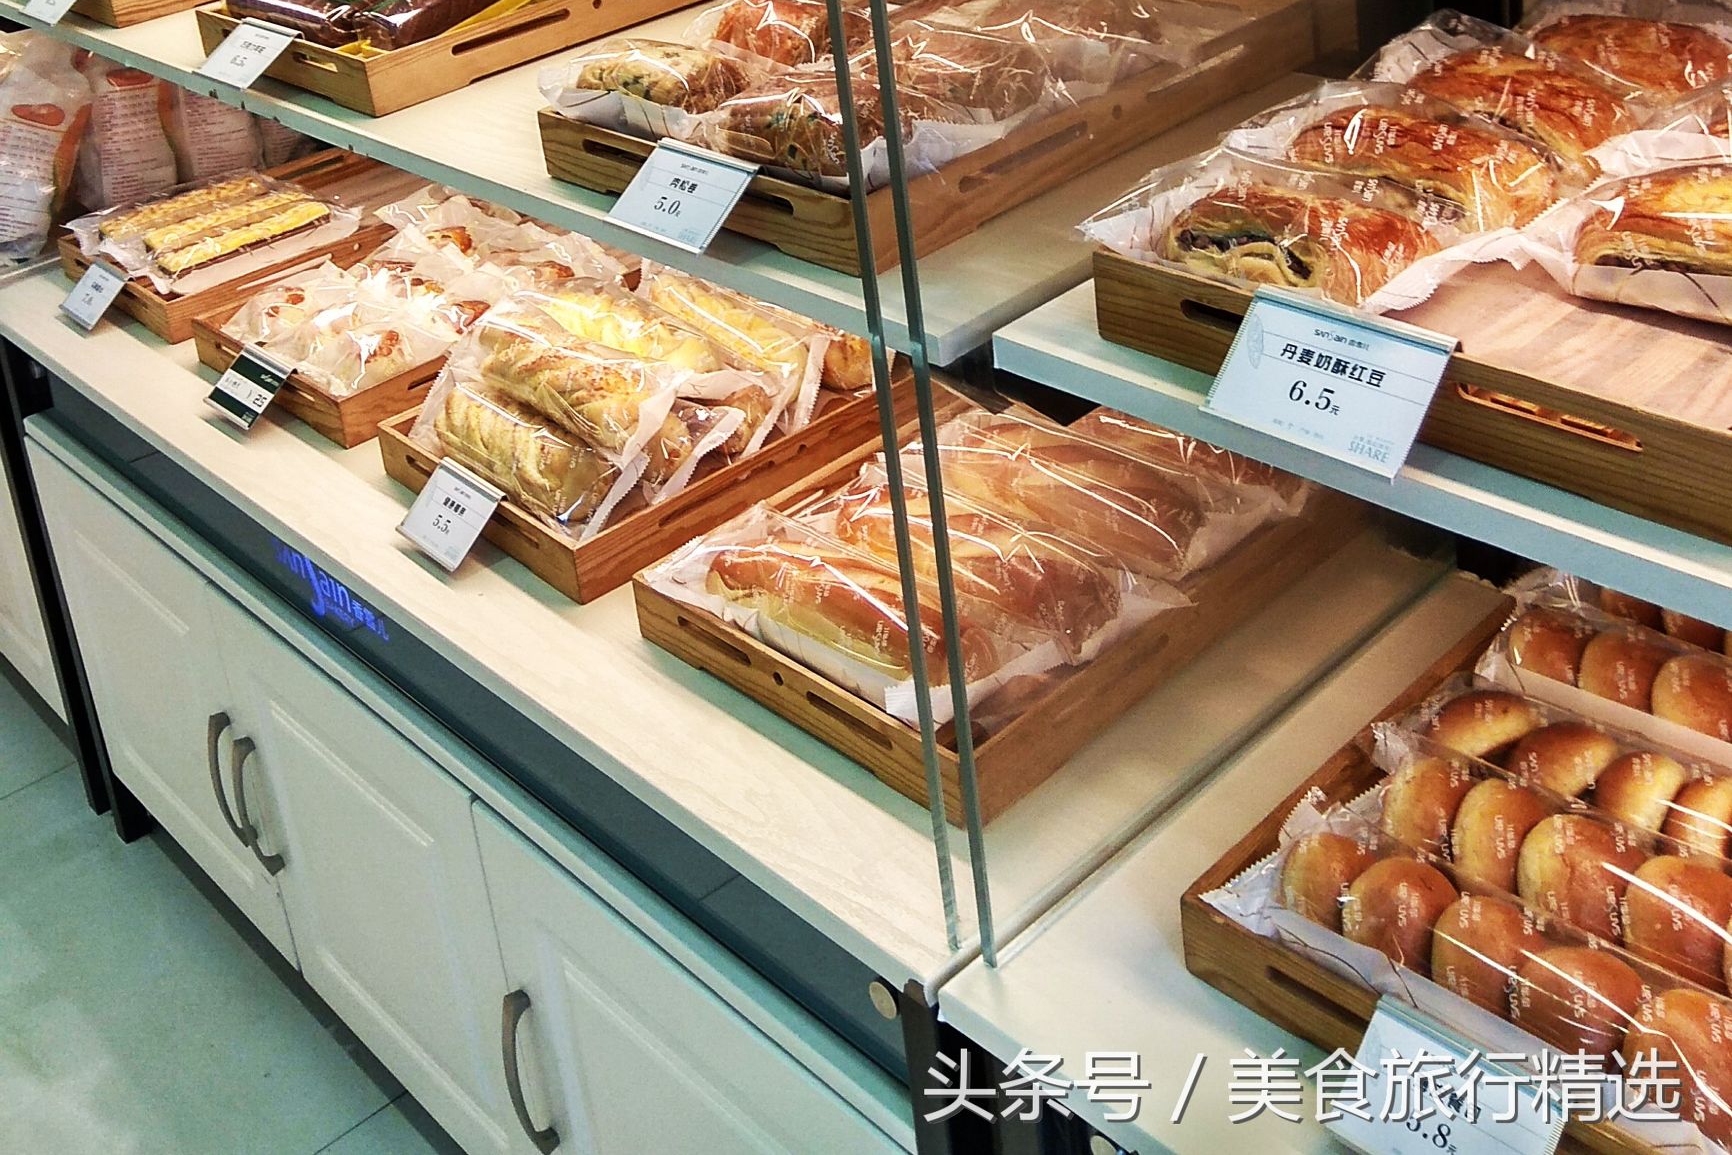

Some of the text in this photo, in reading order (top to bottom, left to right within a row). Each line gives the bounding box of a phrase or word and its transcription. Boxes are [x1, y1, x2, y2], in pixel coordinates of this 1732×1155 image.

[1280, 342, 1387, 388] 丹麦奶酥红豆
